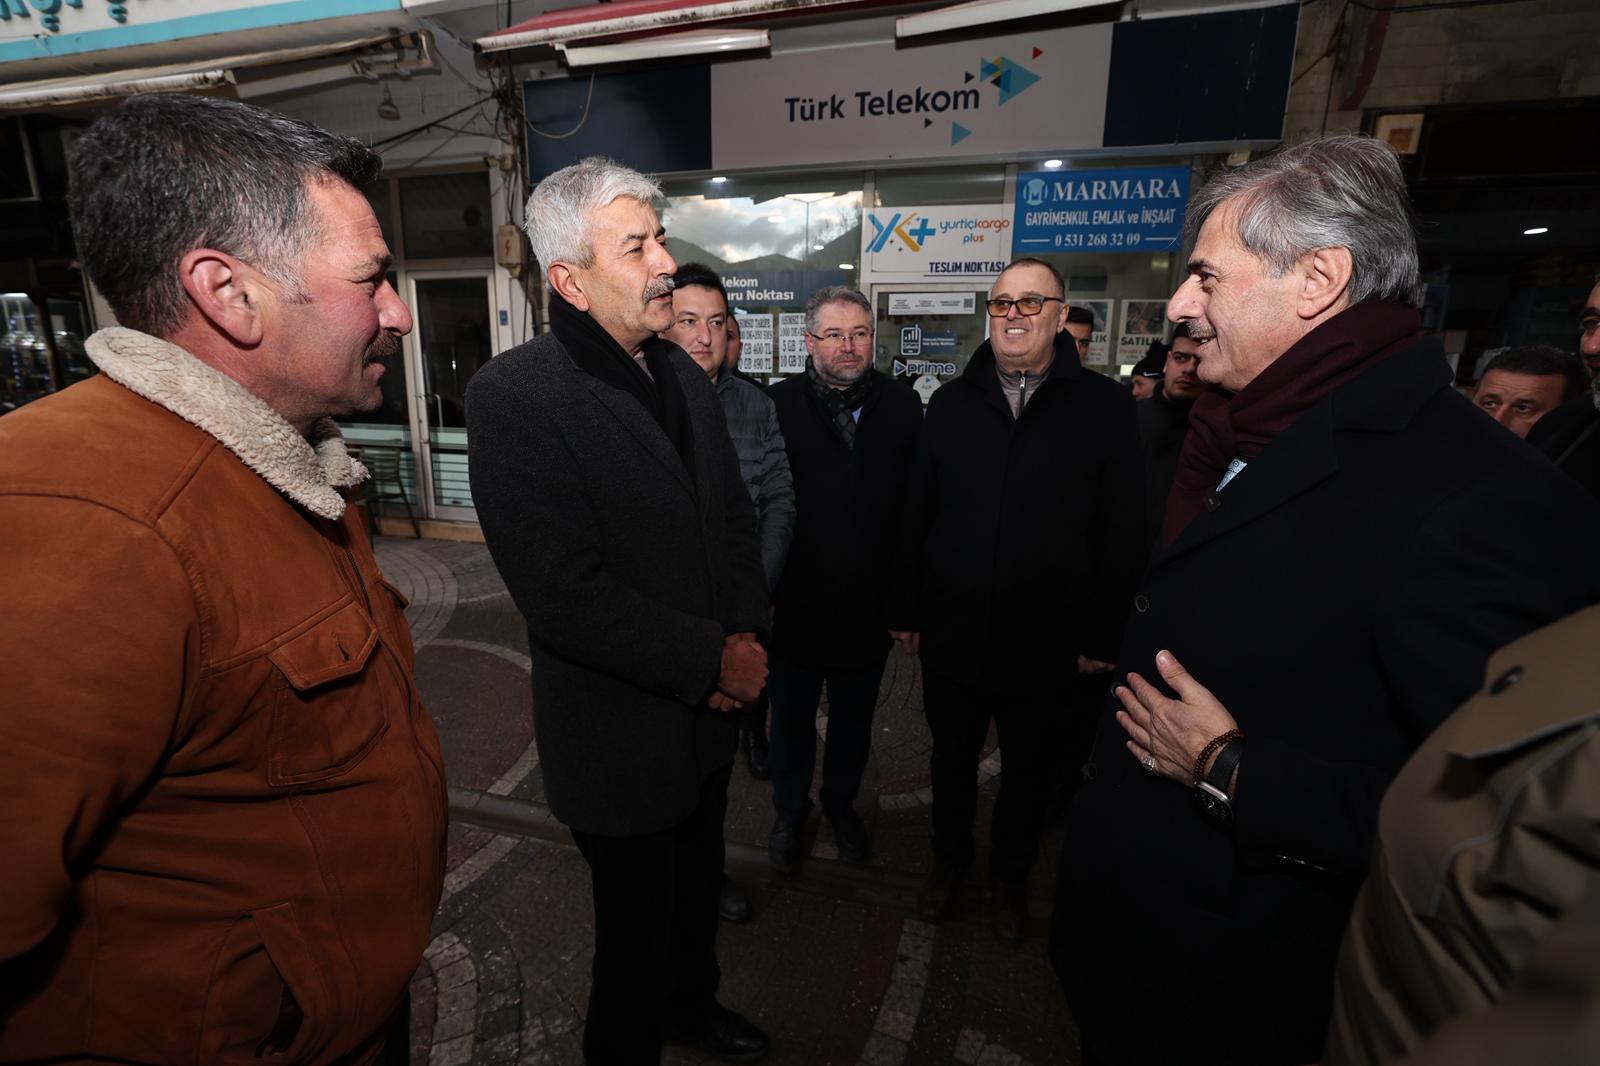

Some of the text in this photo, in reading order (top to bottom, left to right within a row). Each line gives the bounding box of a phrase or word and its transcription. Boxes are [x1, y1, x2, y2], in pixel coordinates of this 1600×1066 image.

[785, 87, 980, 122] Türk Telekom
[1053, 178, 1182, 201] MARMARA
[1025, 206, 1177, 228] GAYRİMENKUL EMLAK ve İNŞAAT
[940, 216, 1010, 234] yurtiçikargo
[963, 233, 984, 245] plus
[1055, 233, 1141, 247] 0 531 268 32 09
[929, 261, 1006, 273] TESLİM NOKTASI
[722, 276, 758, 288] lekom
[746, 289, 794, 300] Noktası
[907, 361, 955, 375] prime
